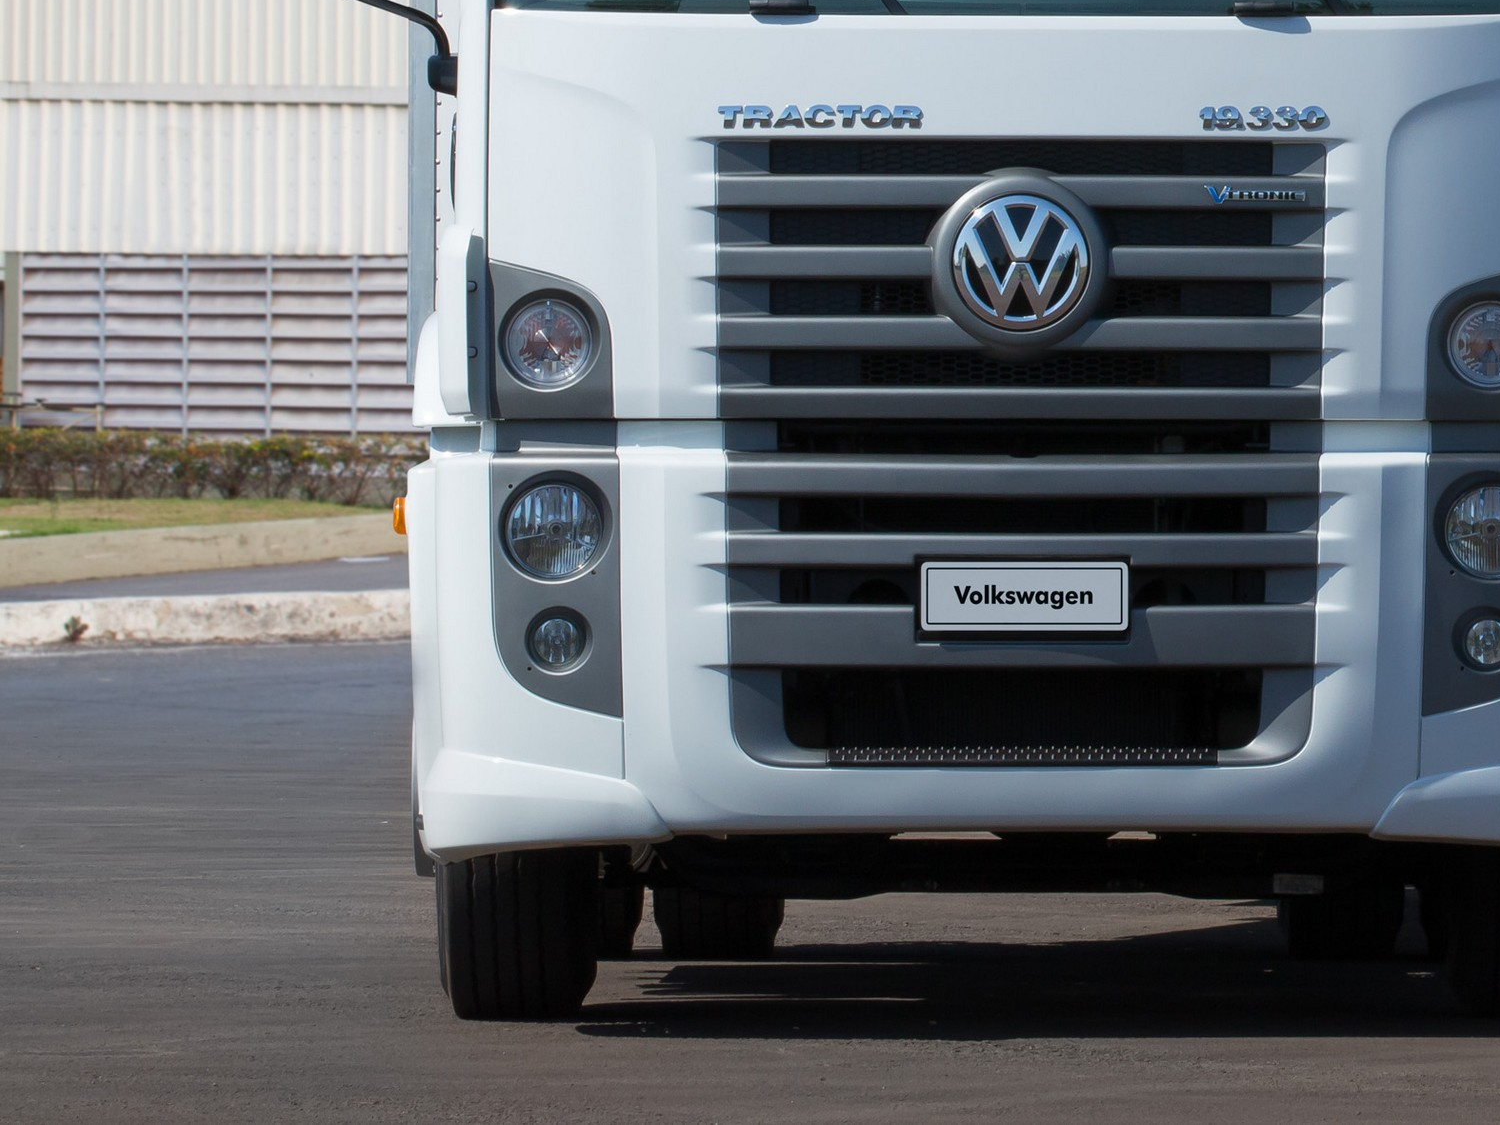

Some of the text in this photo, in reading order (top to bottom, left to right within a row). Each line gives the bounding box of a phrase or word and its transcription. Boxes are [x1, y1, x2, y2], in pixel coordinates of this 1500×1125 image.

[718, 104, 924, 129] TRACTOR
[953, 194, 1088, 331] VW
[953, 585, 1094, 610] Volkswagen
